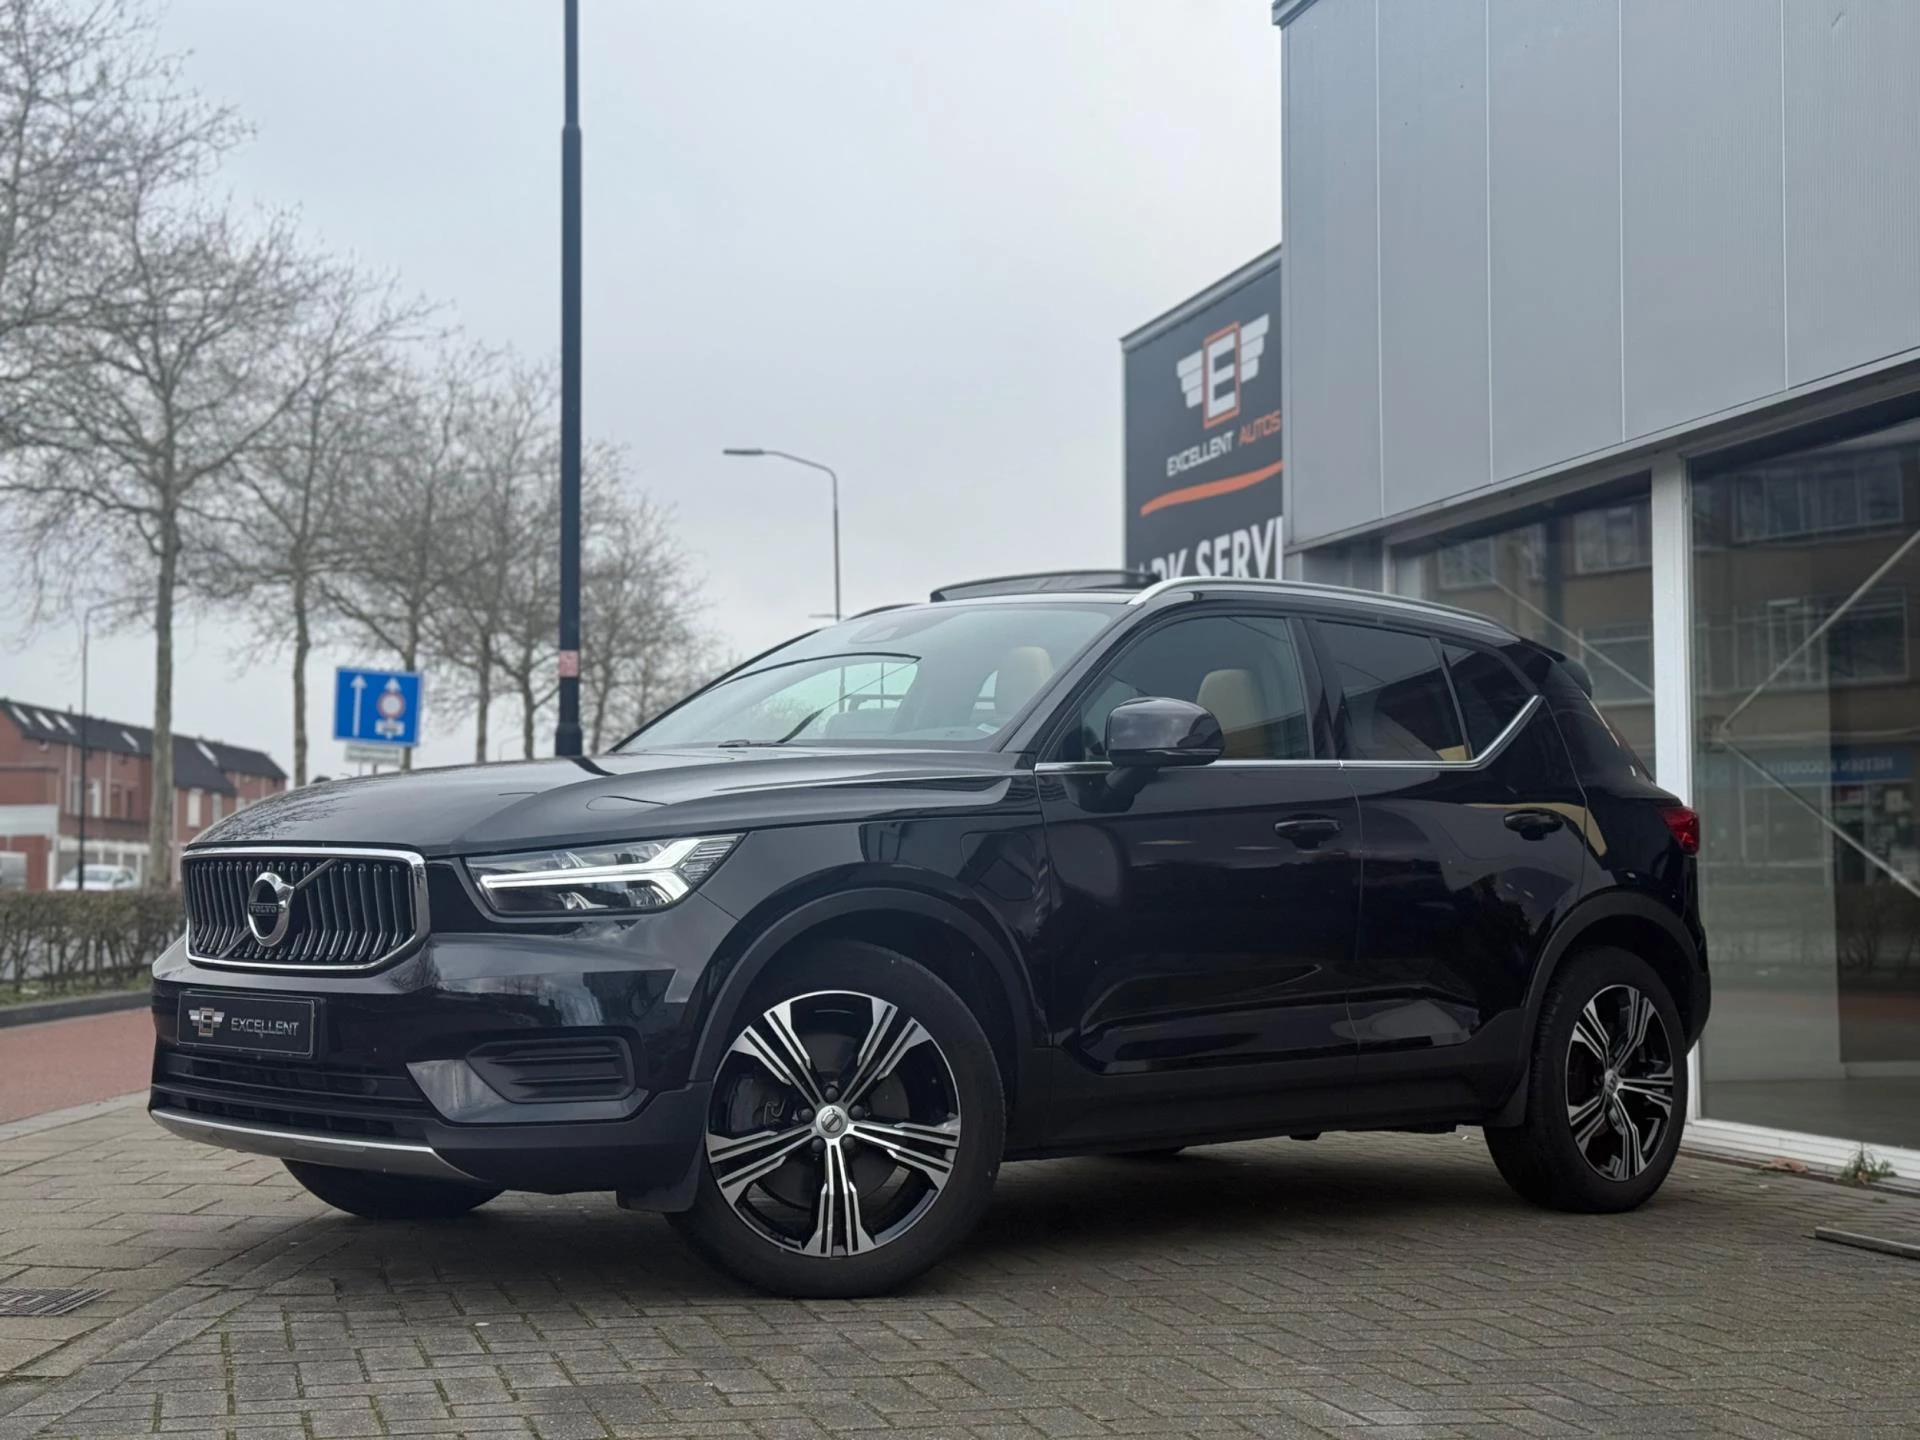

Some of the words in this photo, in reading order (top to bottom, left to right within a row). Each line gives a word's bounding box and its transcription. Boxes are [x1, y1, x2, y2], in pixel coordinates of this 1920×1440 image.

[1165, 430, 1235, 477] EXCELLENT
[1238, 409, 1281, 446] AUTOS
[231, 1017, 299, 1036] EXCELLENT
